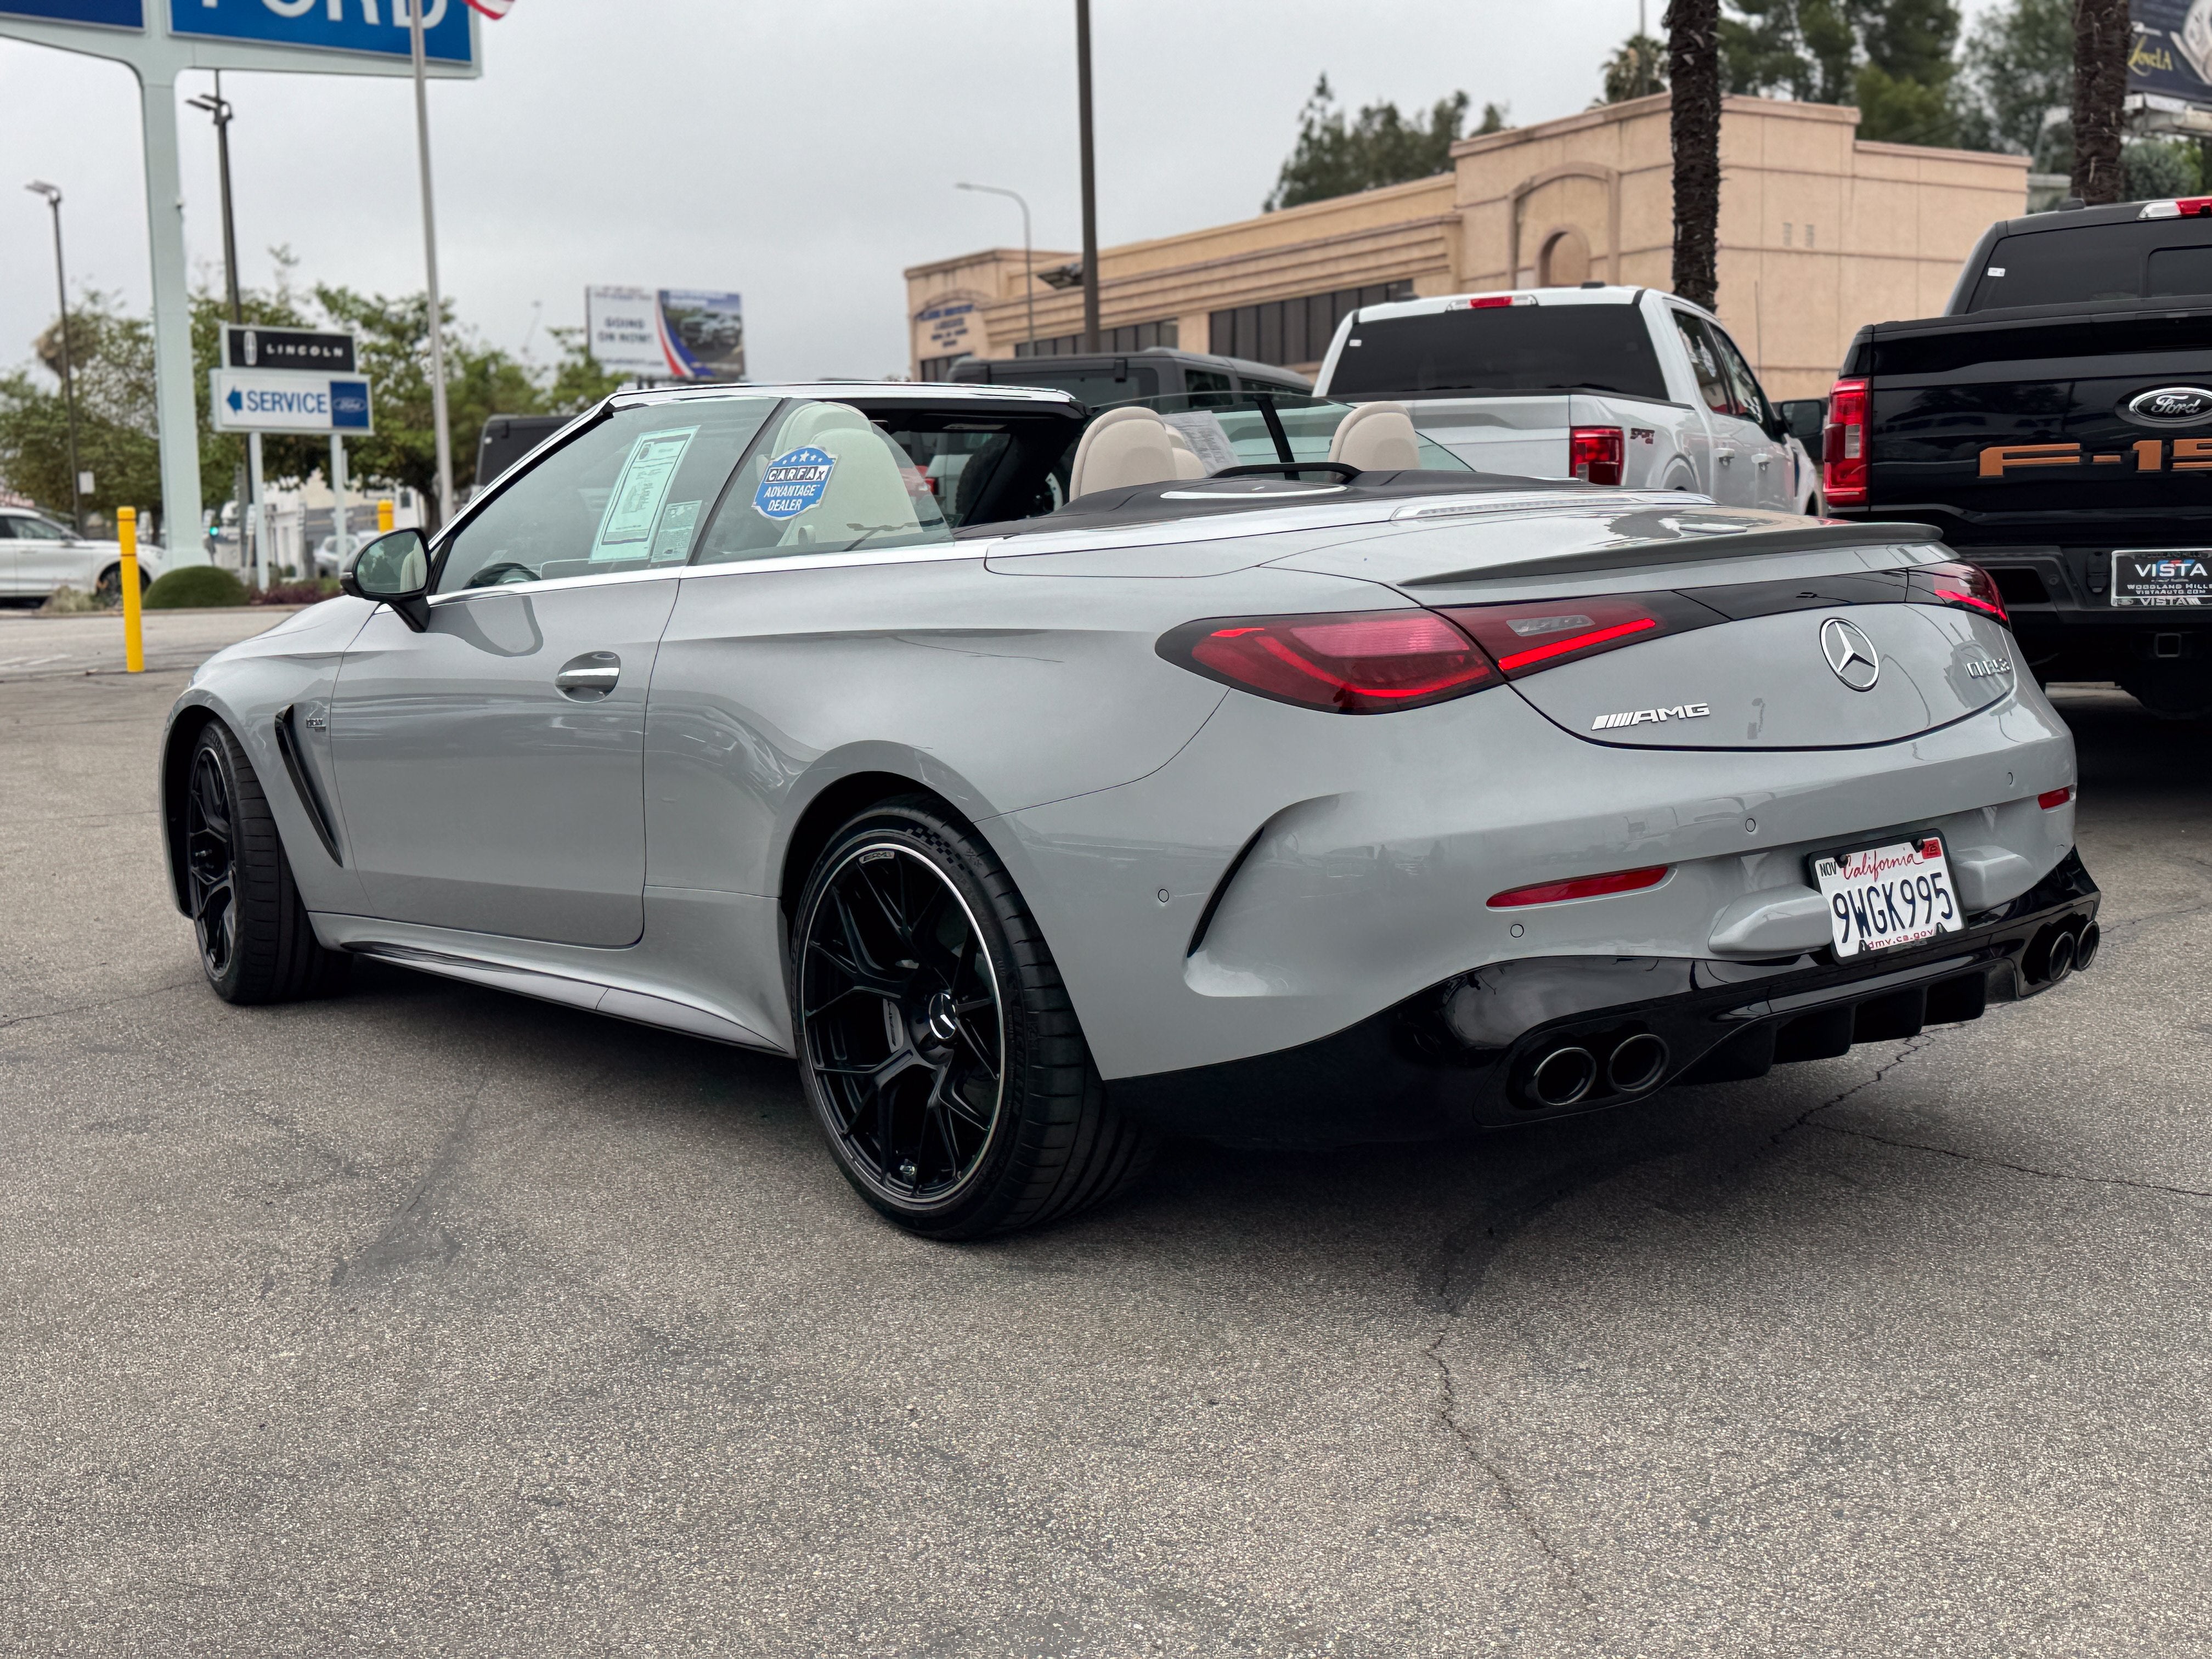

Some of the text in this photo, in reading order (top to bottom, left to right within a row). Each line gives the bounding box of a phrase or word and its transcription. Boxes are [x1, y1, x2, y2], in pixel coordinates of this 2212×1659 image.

[266, 343, 343, 358] LINCOLN
[247, 390, 328, 413] SERVICE
[2150, 395, 2201, 414] Ford
[768, 466, 826, 482] CARFAX
[764, 484, 817, 498] ADVANTAGE
[768, 499, 803, 511] DEALER
[2135, 563, 2208, 577] VISTA
[1631, 703, 1711, 725] AMG
[1819, 850, 1925, 882] NOV California
[1832, 872, 1953, 944] 9WGK995
[1868, 928, 1934, 950] dmv.ca.gov
